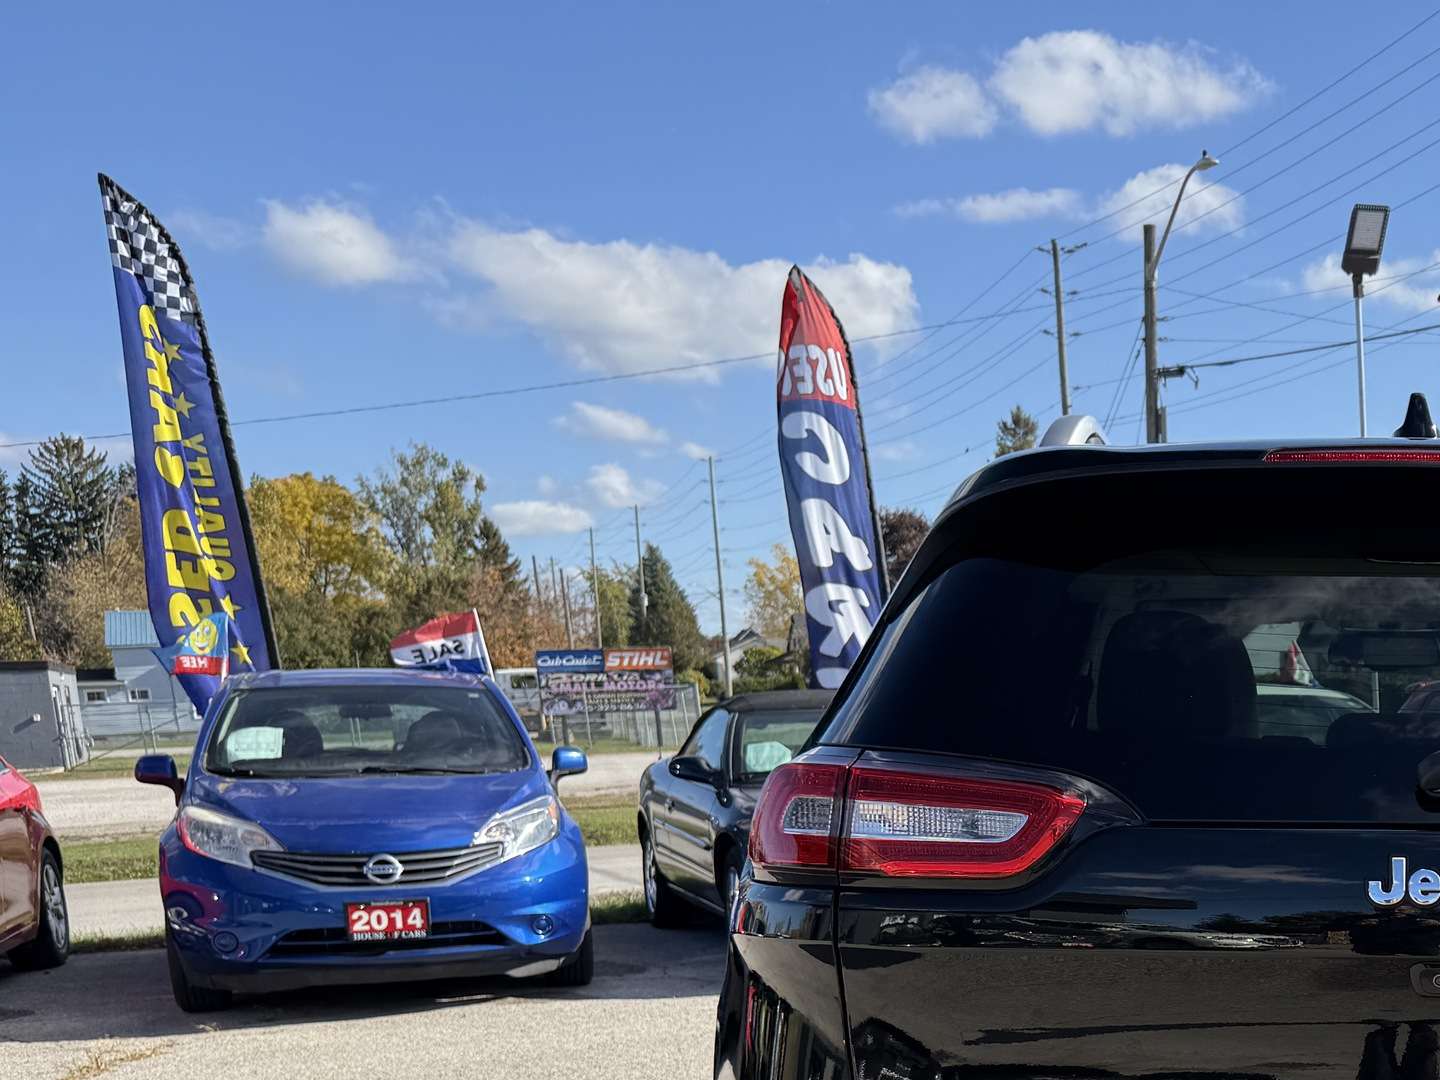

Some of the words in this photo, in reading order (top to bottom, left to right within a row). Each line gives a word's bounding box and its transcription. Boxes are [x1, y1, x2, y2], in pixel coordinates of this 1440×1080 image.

[537, 656, 561, 667] Cub
[563, 655, 602, 666] Cadet
[607, 651, 669, 667] STIHL
[550, 681, 598, 694] SMALL
[351, 907, 424, 932] 2014
[401, 929, 427, 939] CARS
